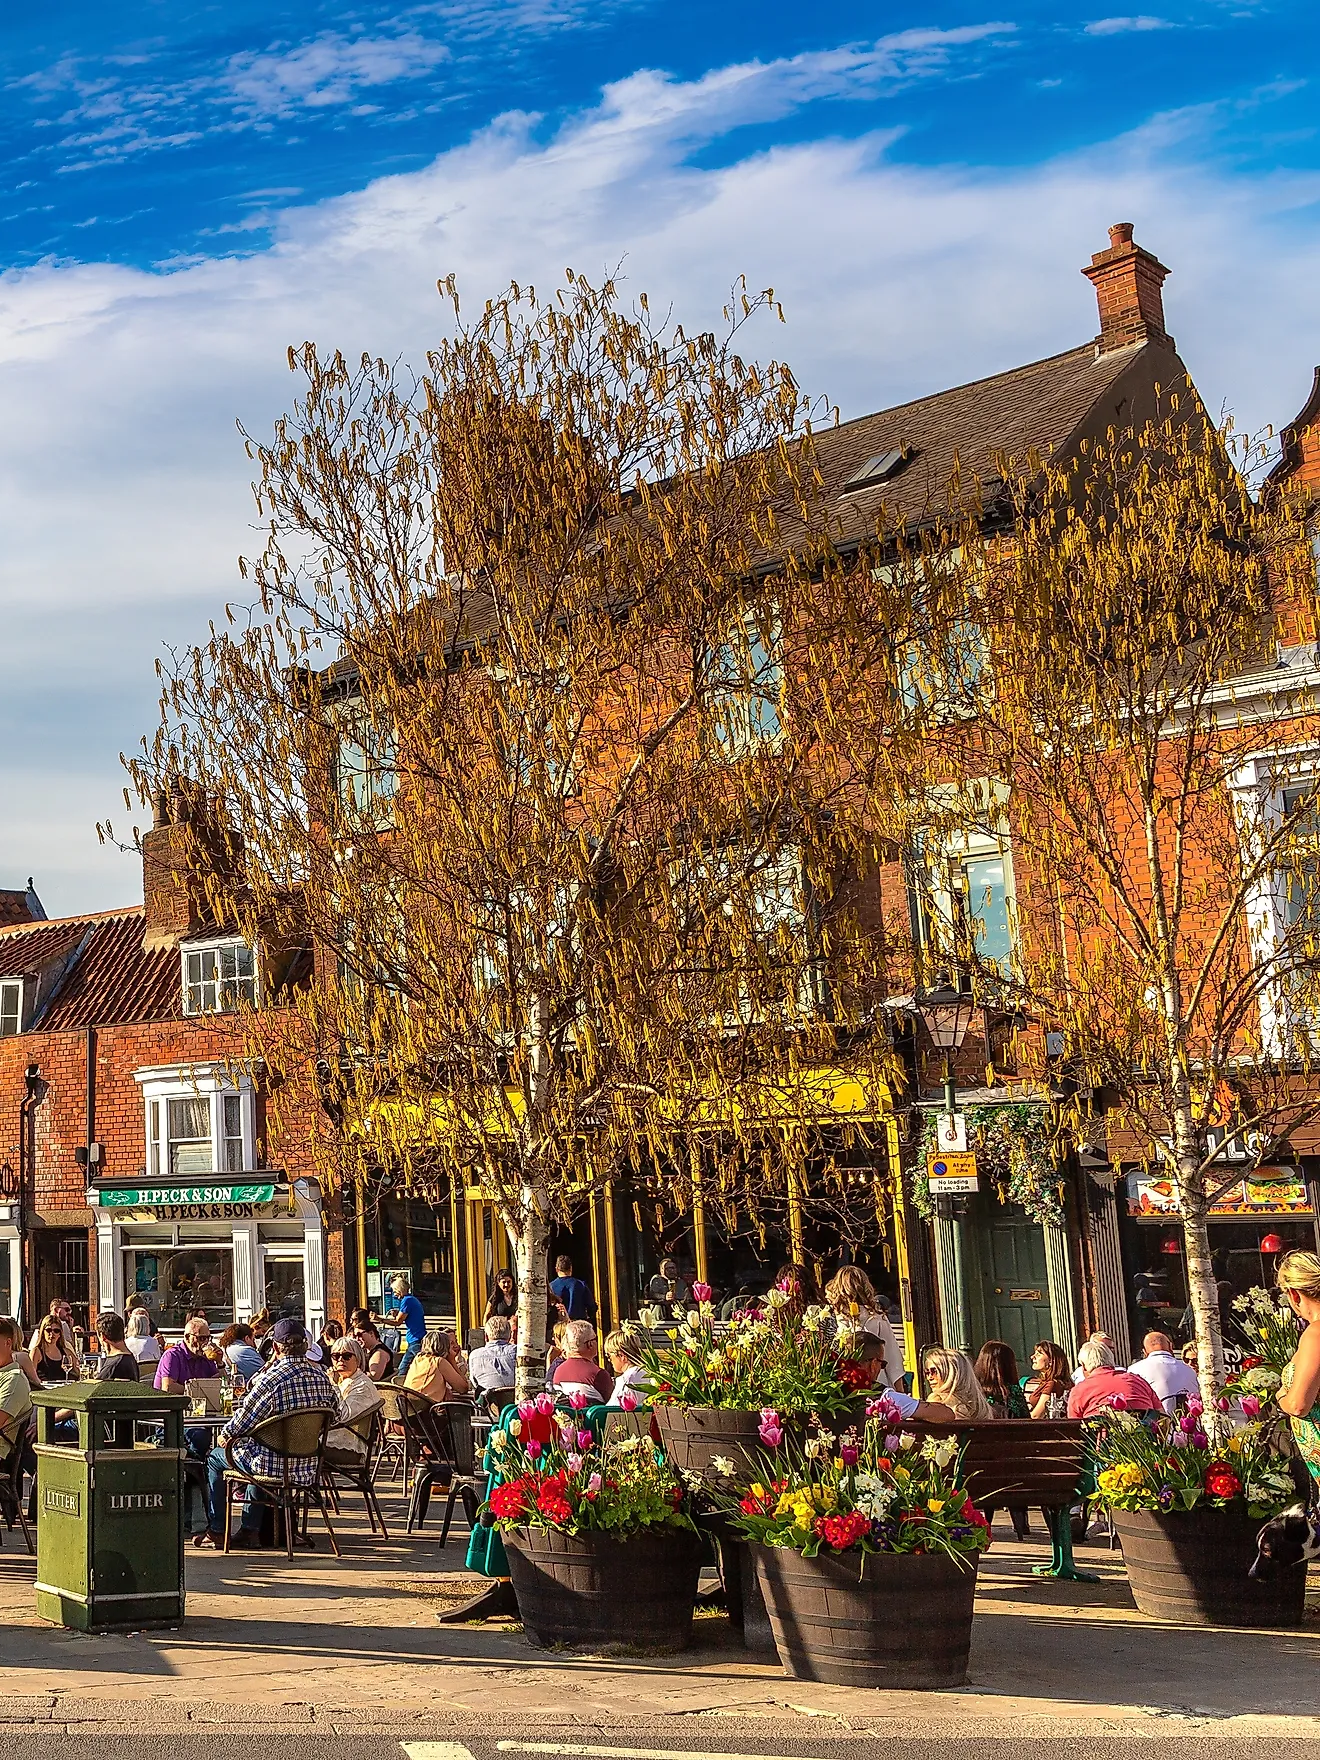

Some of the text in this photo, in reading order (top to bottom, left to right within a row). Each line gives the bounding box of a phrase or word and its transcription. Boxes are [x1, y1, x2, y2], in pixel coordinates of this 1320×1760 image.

[137, 1187, 232, 1203] H.PECK & SON
[210, 1203, 222, 1217] &
[223, 1202, 254, 1218] SON
[46, 1490, 77, 1510] LITTER
[111, 1494, 163, 1509] LITTER
